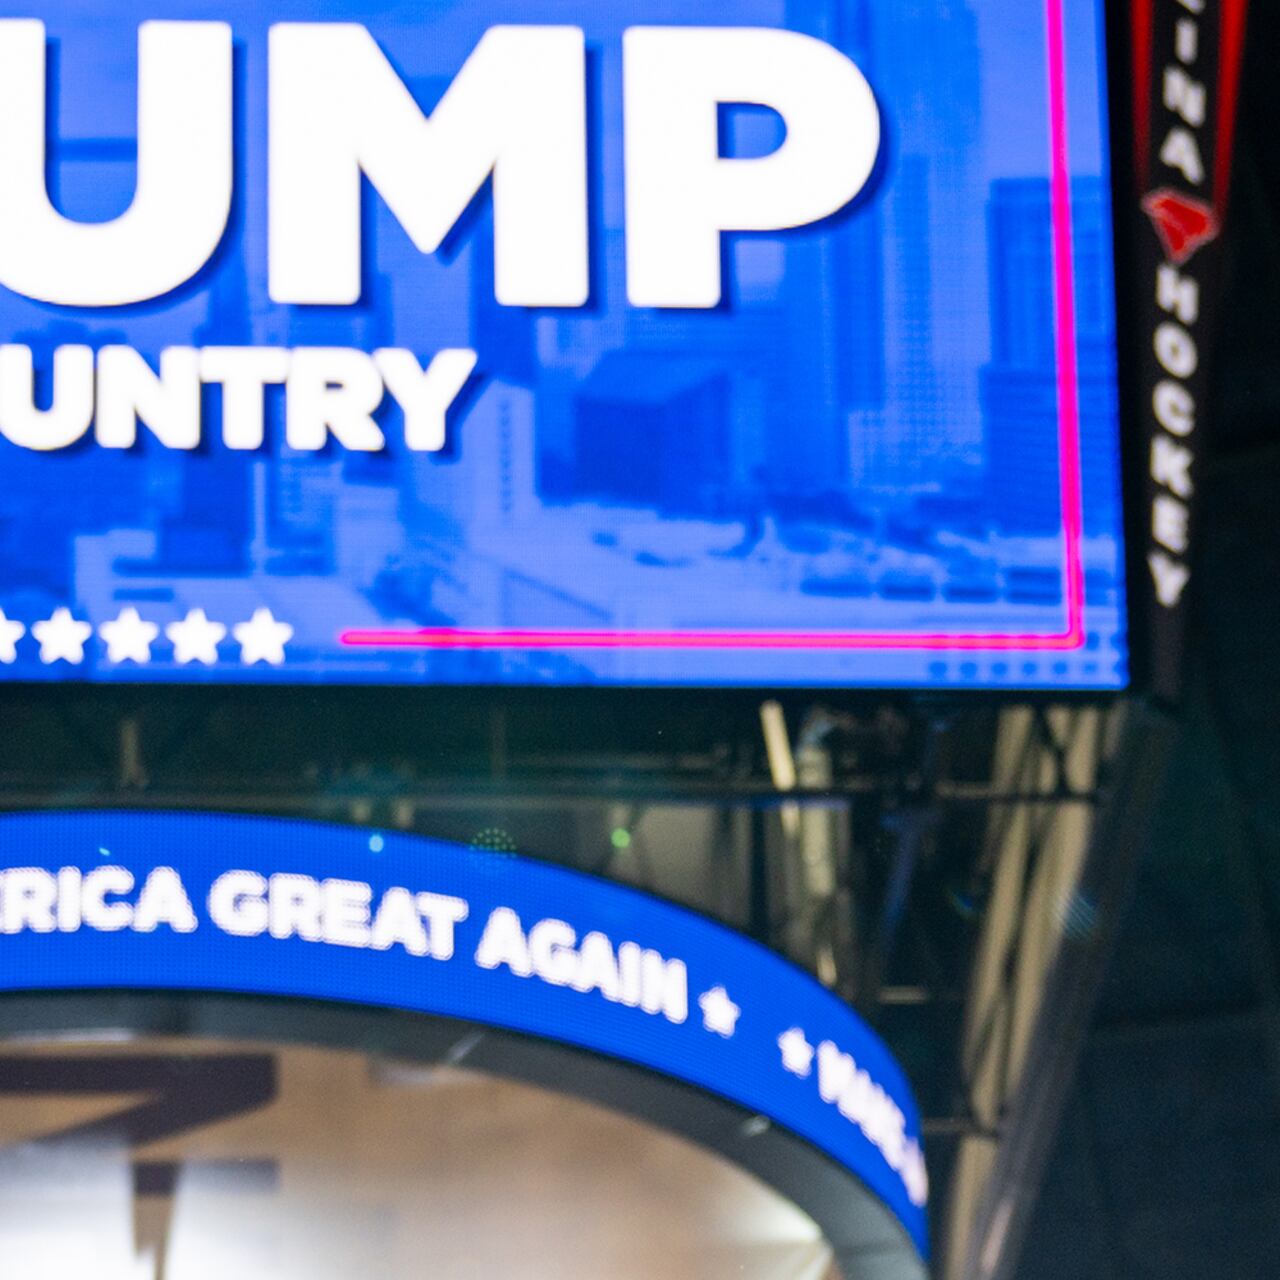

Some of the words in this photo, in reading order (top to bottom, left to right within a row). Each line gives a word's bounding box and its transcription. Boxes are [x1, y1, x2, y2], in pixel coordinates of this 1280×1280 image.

[1148, 262, 1200, 609] HOCKEY
[207, 870, 470, 961] GREAT
[475, 907, 689, 1024] AGAIN
